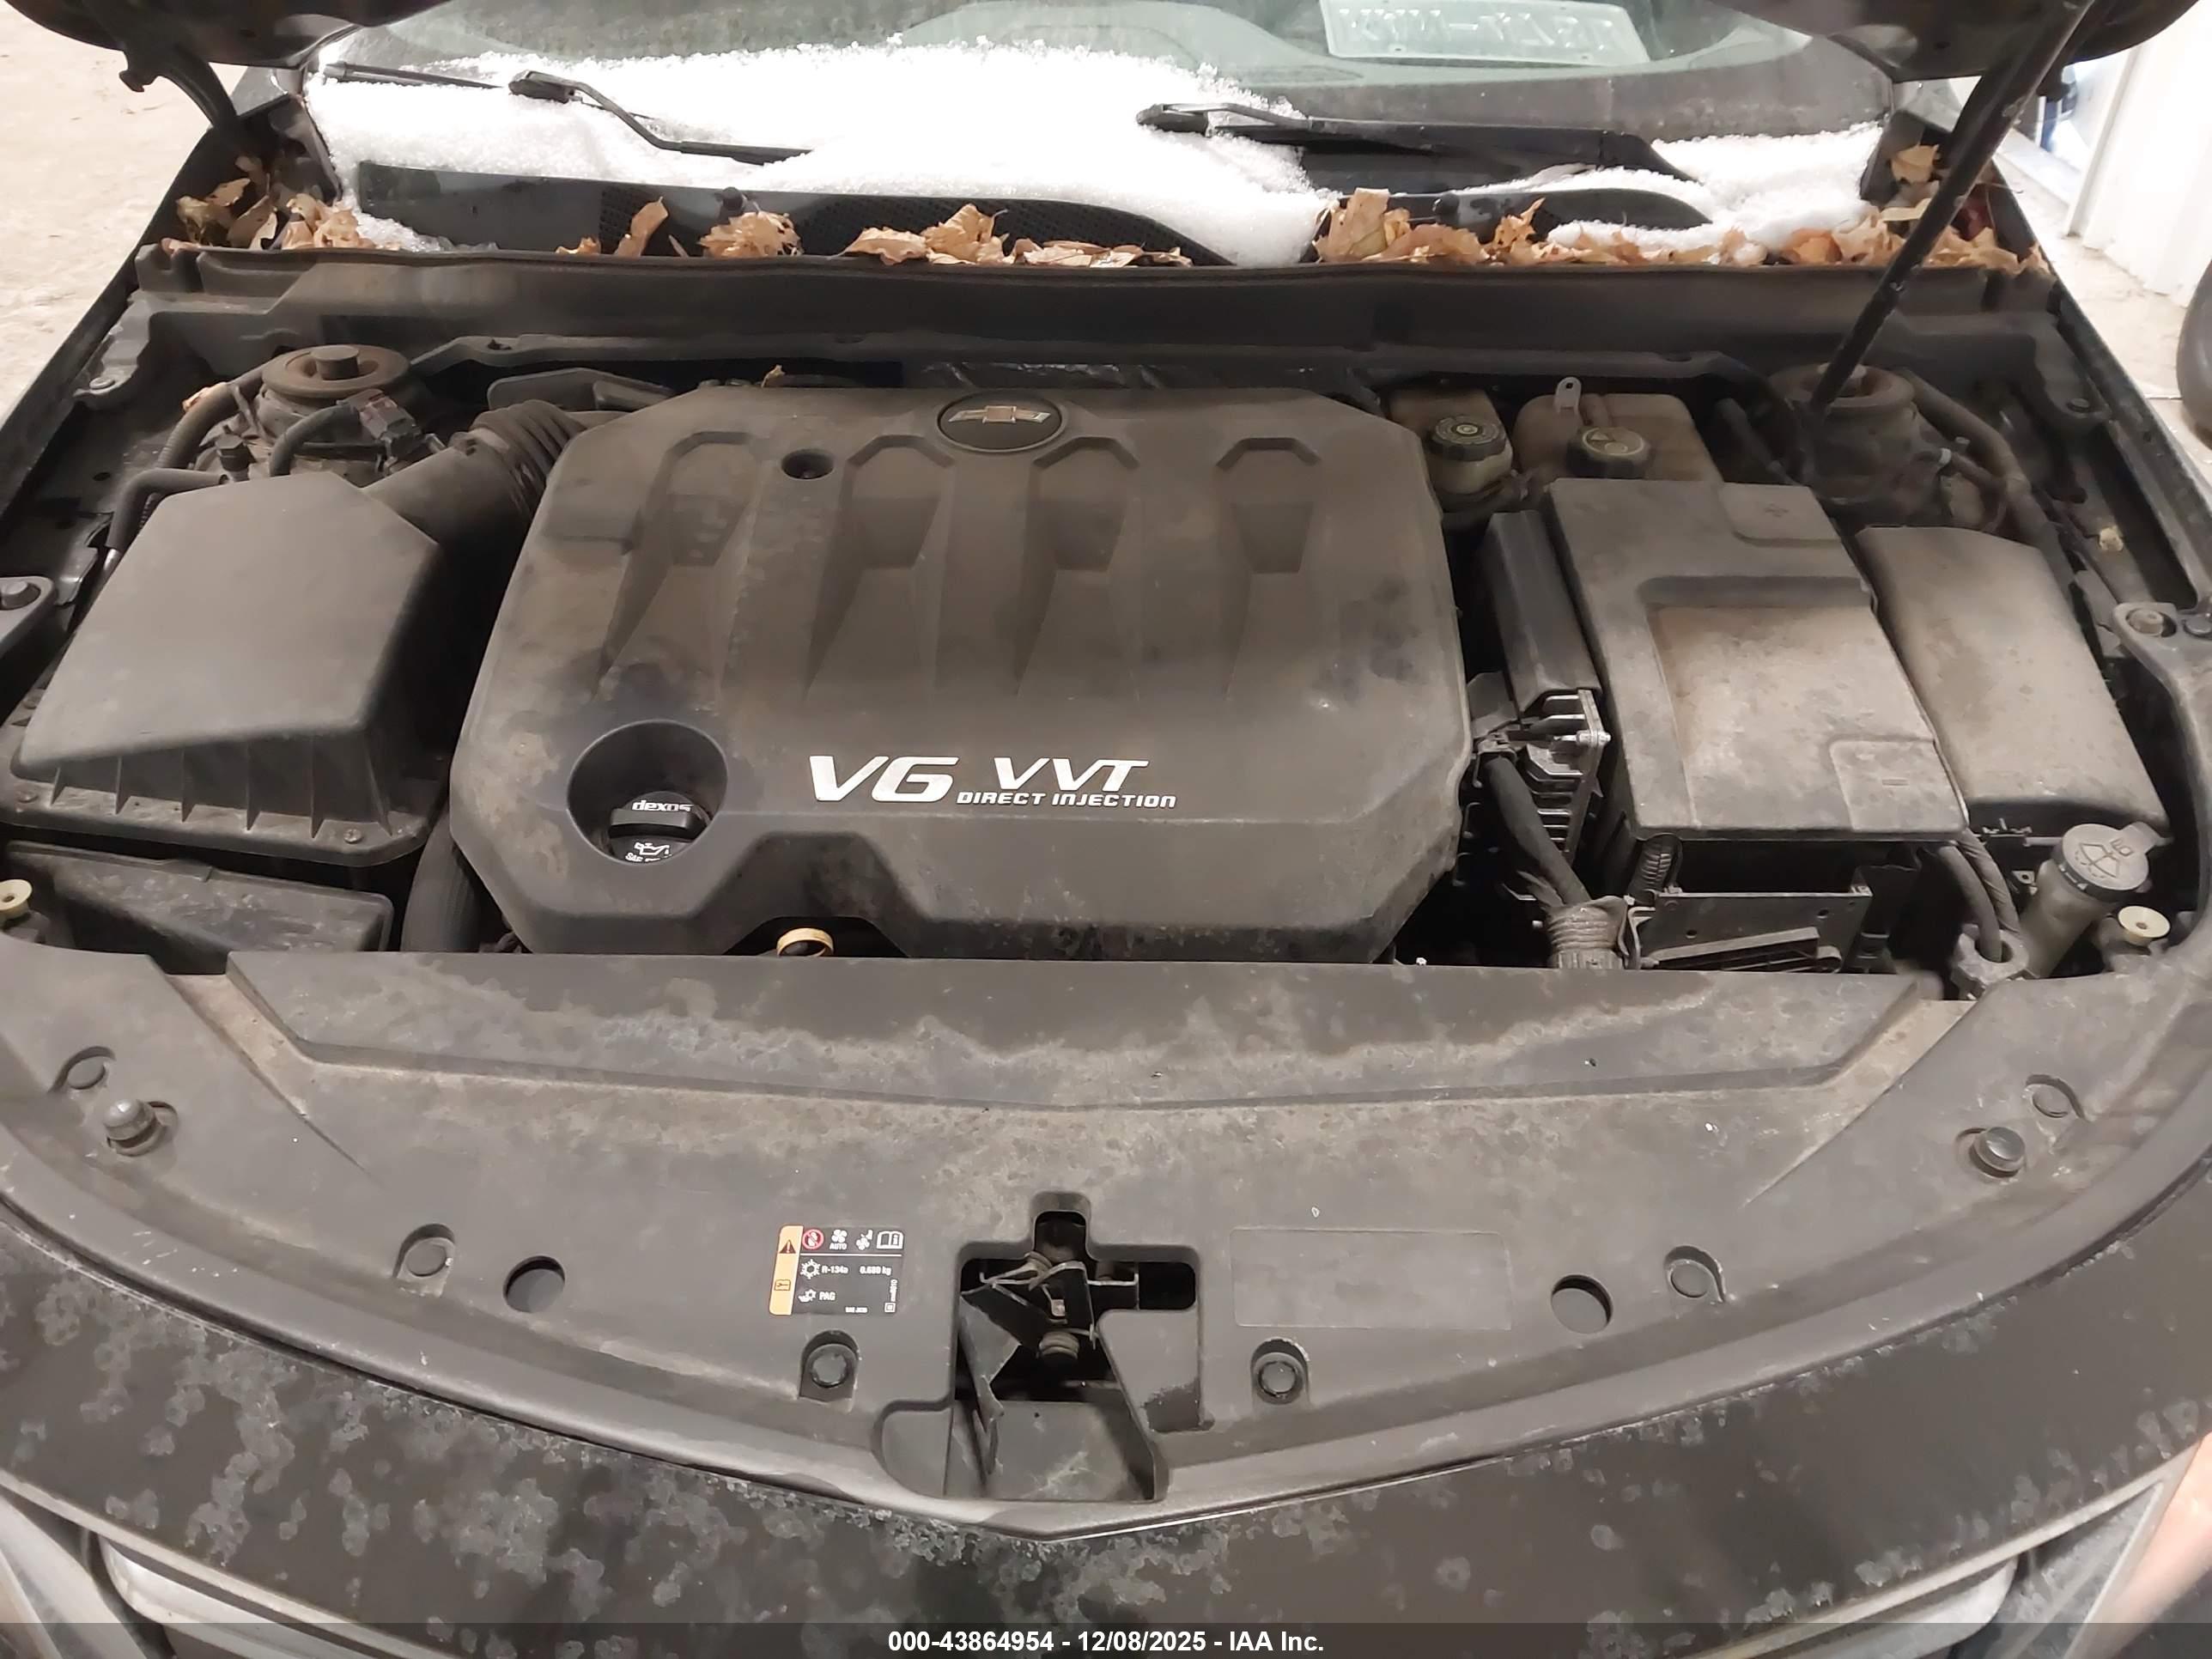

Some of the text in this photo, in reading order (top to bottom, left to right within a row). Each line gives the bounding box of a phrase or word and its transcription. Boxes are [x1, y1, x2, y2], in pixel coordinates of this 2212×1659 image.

[809, 756, 1149, 803] V6 VVT
[632, 799, 694, 811] dexos
[957, 791, 1176, 808] DIRECT INJECTION
[819, 1291, 836, 1300] PAG
